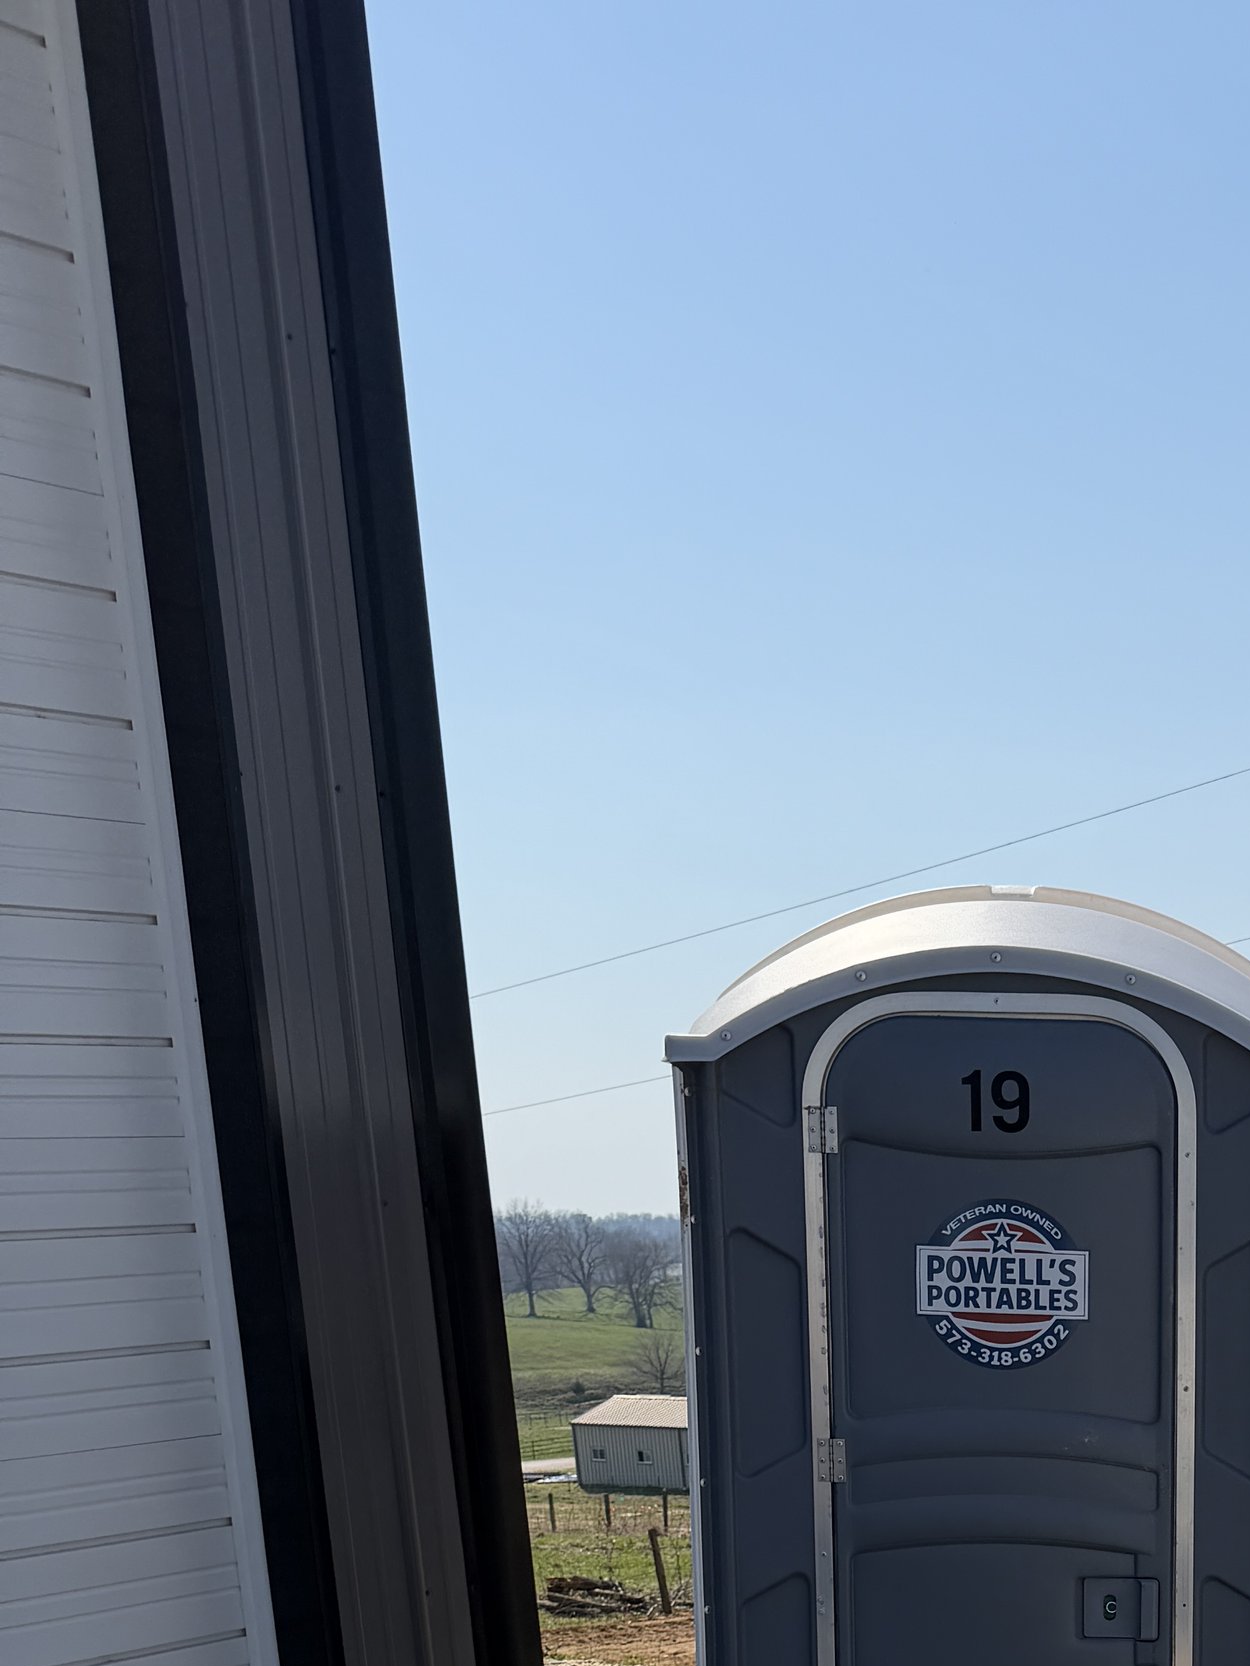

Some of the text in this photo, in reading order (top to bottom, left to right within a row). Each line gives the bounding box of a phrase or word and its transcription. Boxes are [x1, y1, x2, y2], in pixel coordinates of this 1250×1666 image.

[961, 1069, 1030, 1134] 19
[941, 1204, 1062, 1240] VETERAN OWNED
[926, 1254, 1077, 1287] POWELL'S
[926, 1285, 1078, 1312] PORTABLES
[935, 1319, 1069, 1366] 573-318-6302
